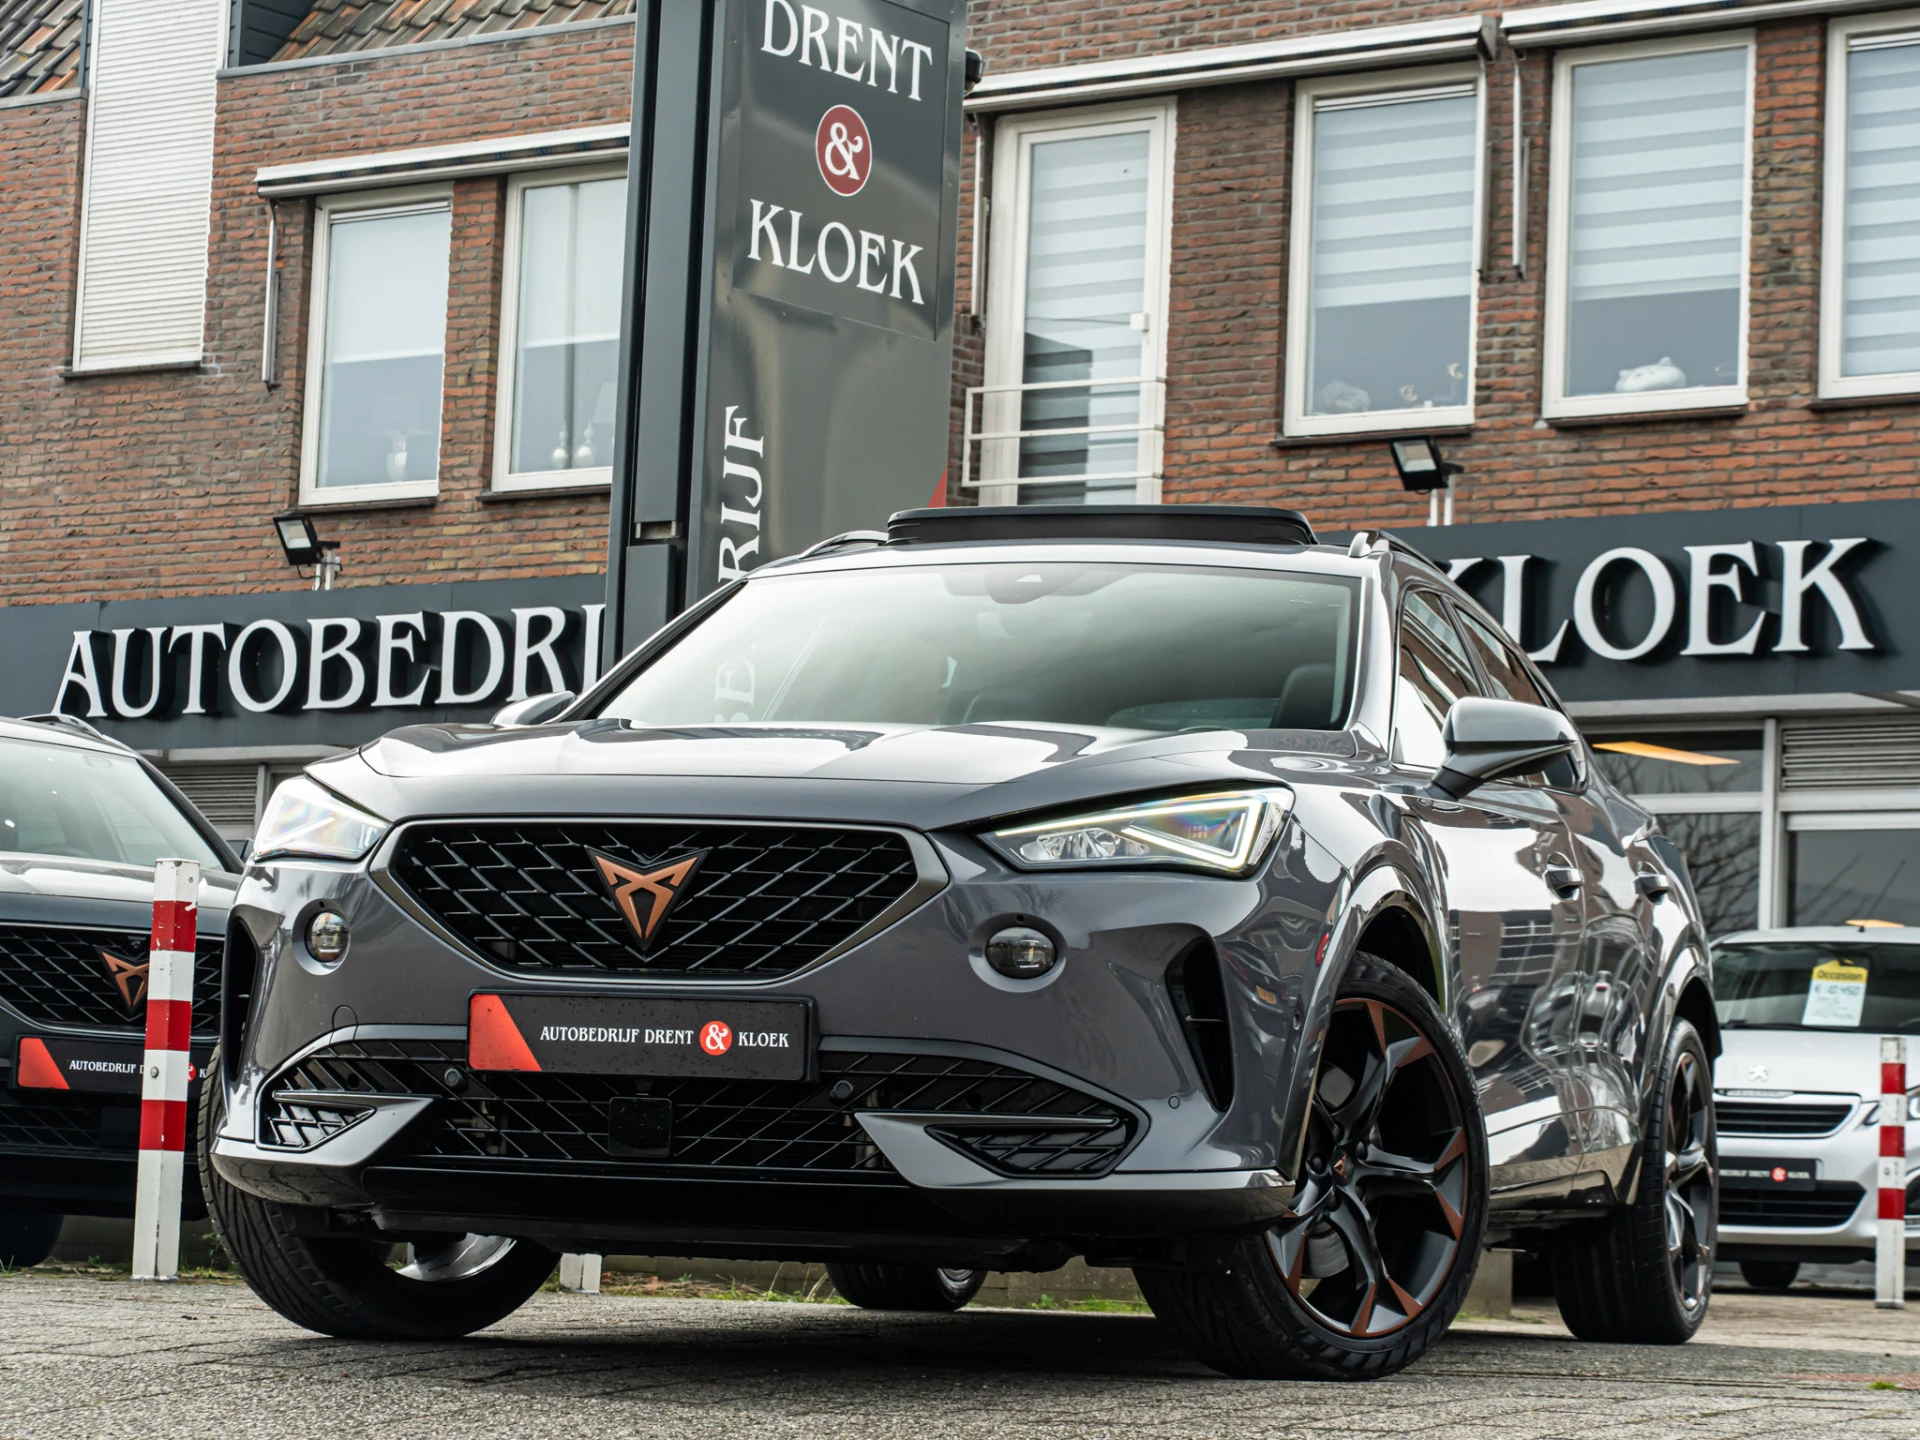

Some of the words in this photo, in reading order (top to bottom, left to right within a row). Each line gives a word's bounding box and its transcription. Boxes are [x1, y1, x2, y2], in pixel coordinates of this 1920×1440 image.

[761, 0, 933, 101] DRENT
[825, 122, 863, 181] &
[747, 199, 924, 305] KLOEK
[1446, 537, 1875, 661] LOEK
[1817, 969, 1864, 980] Occasion
[69, 1059, 136, 1074] AUTOBEDRIJF
[540, 1026, 640, 1043] AUTOBEDRIJF
[644, 1029, 694, 1045] DRENT
[705, 1024, 728, 1050] &
[738, 1032, 789, 1048] KLOEK
